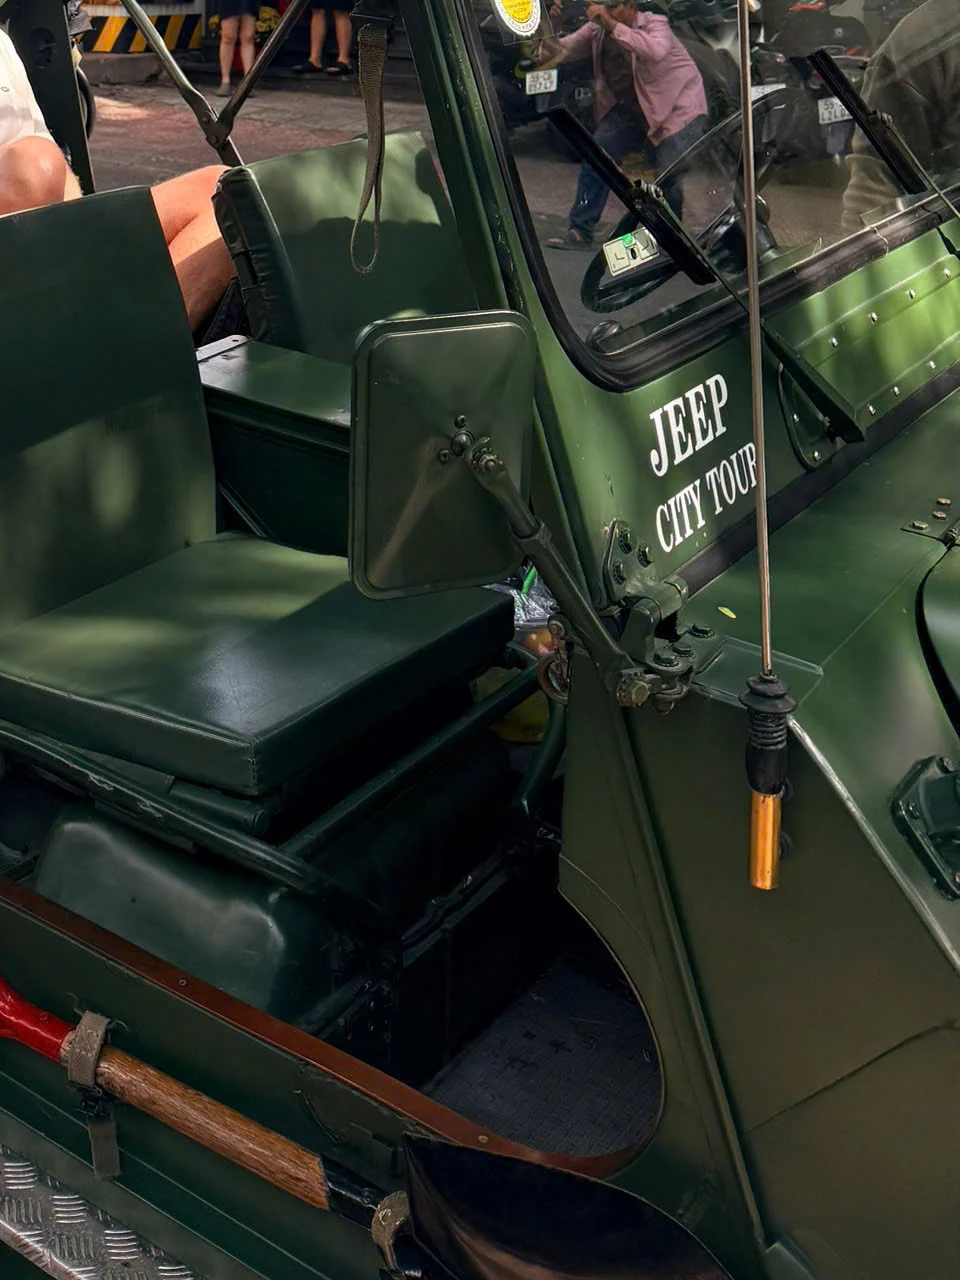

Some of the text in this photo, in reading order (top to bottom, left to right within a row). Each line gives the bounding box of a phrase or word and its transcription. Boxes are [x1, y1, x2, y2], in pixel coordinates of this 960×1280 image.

[648, 373, 729, 477] JEEP
[655, 441, 758, 553] CITY TOUR
